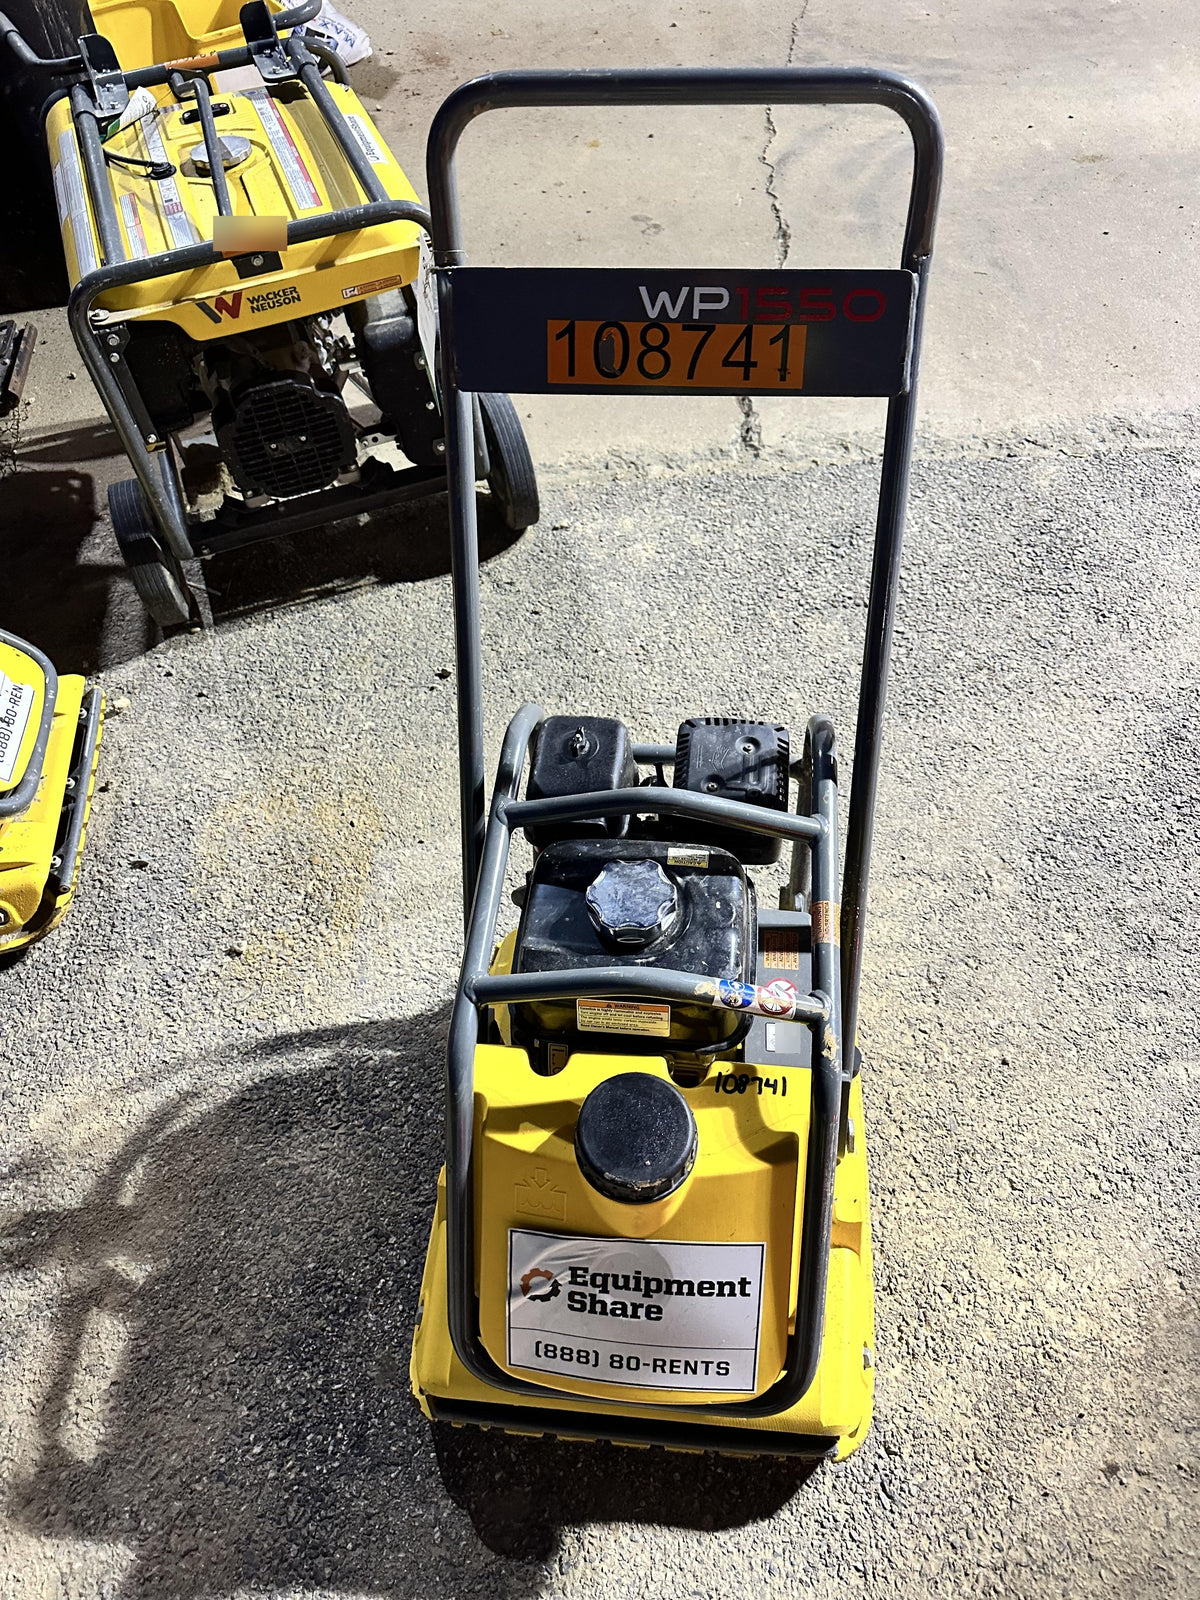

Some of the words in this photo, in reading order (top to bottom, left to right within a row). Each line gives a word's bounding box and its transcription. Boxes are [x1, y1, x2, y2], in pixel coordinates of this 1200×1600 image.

[246, 286, 299, 305] WACKER
[250, 294, 302, 314] NEUSON
[638, 285, 886, 322] WP1550
[555, 319, 791, 382] 108741
[715, 1072, 787, 1097] 108741
[567, 1266, 752, 1299] Equipment
[567, 1290, 664, 1322] Share
[534, 1340, 600, 1368] (888)
[609, 1354, 731, 1377] 80-RENTS
